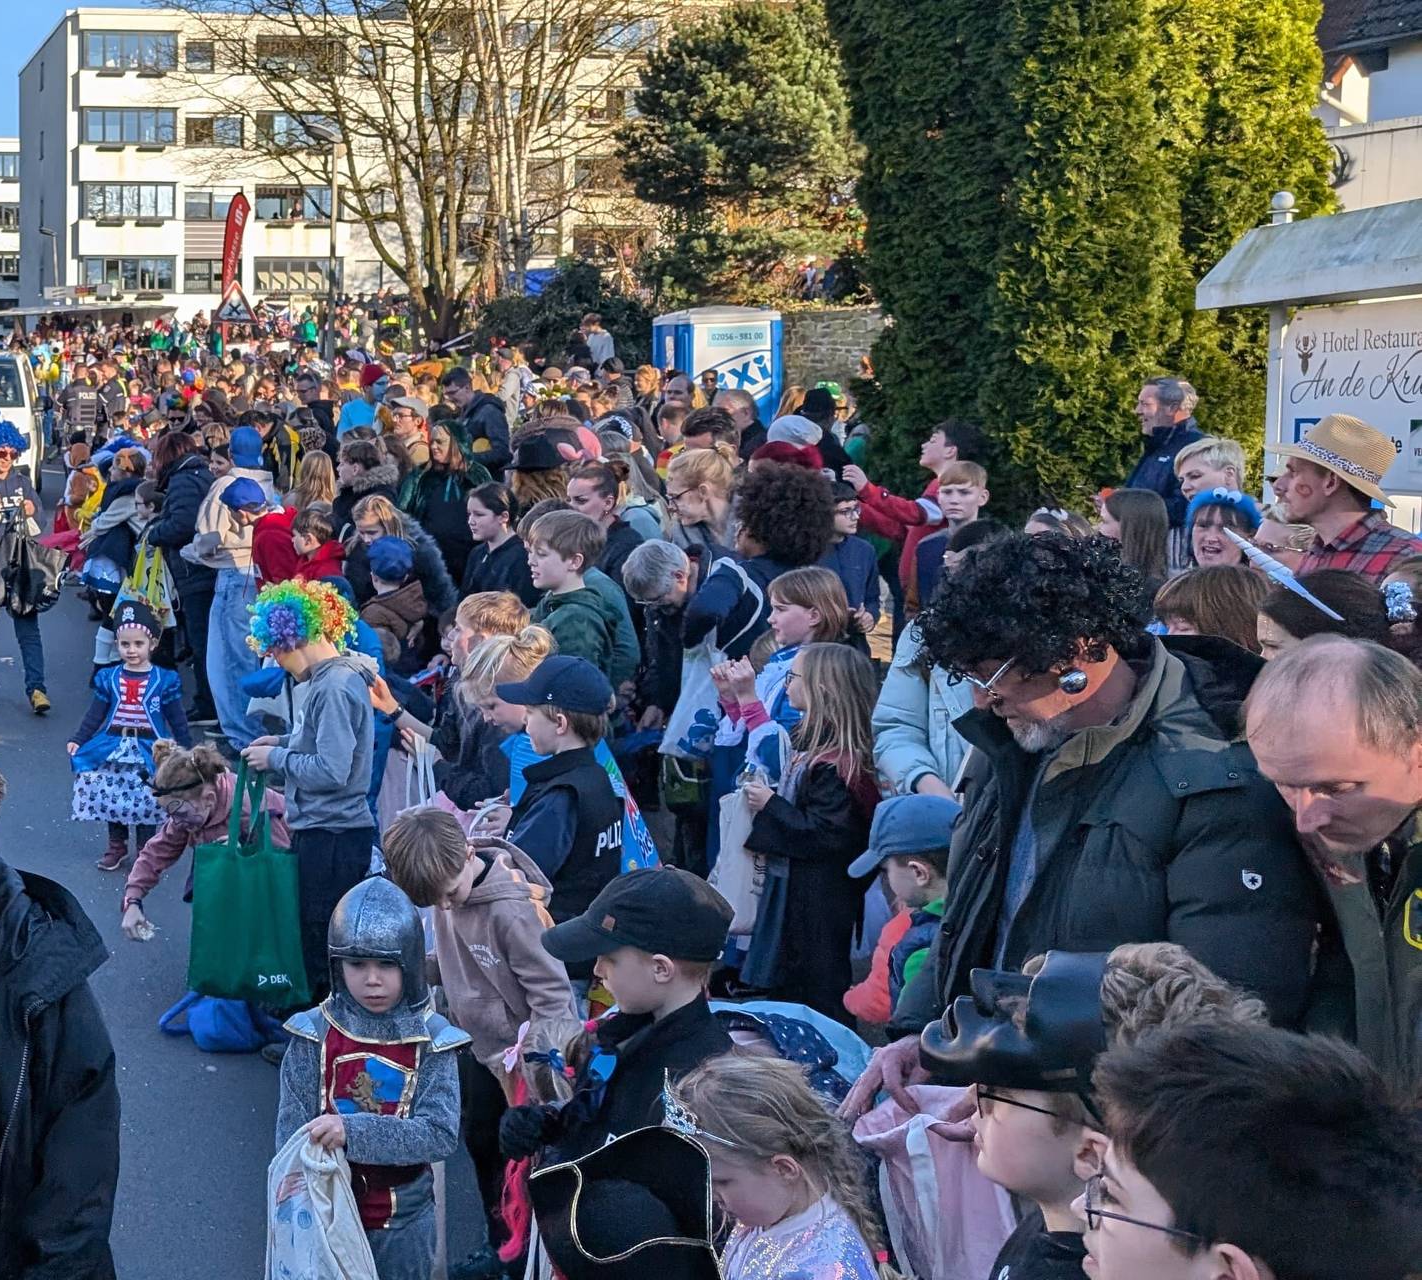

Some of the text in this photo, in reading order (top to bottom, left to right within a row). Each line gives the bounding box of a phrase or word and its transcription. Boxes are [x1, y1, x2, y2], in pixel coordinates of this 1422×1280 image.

[1322, 328, 1359, 353] Hotel
[1290, 358, 1335, 404] An
[1339, 360, 1365, 397] de
[270, 974, 293, 987] DEK
